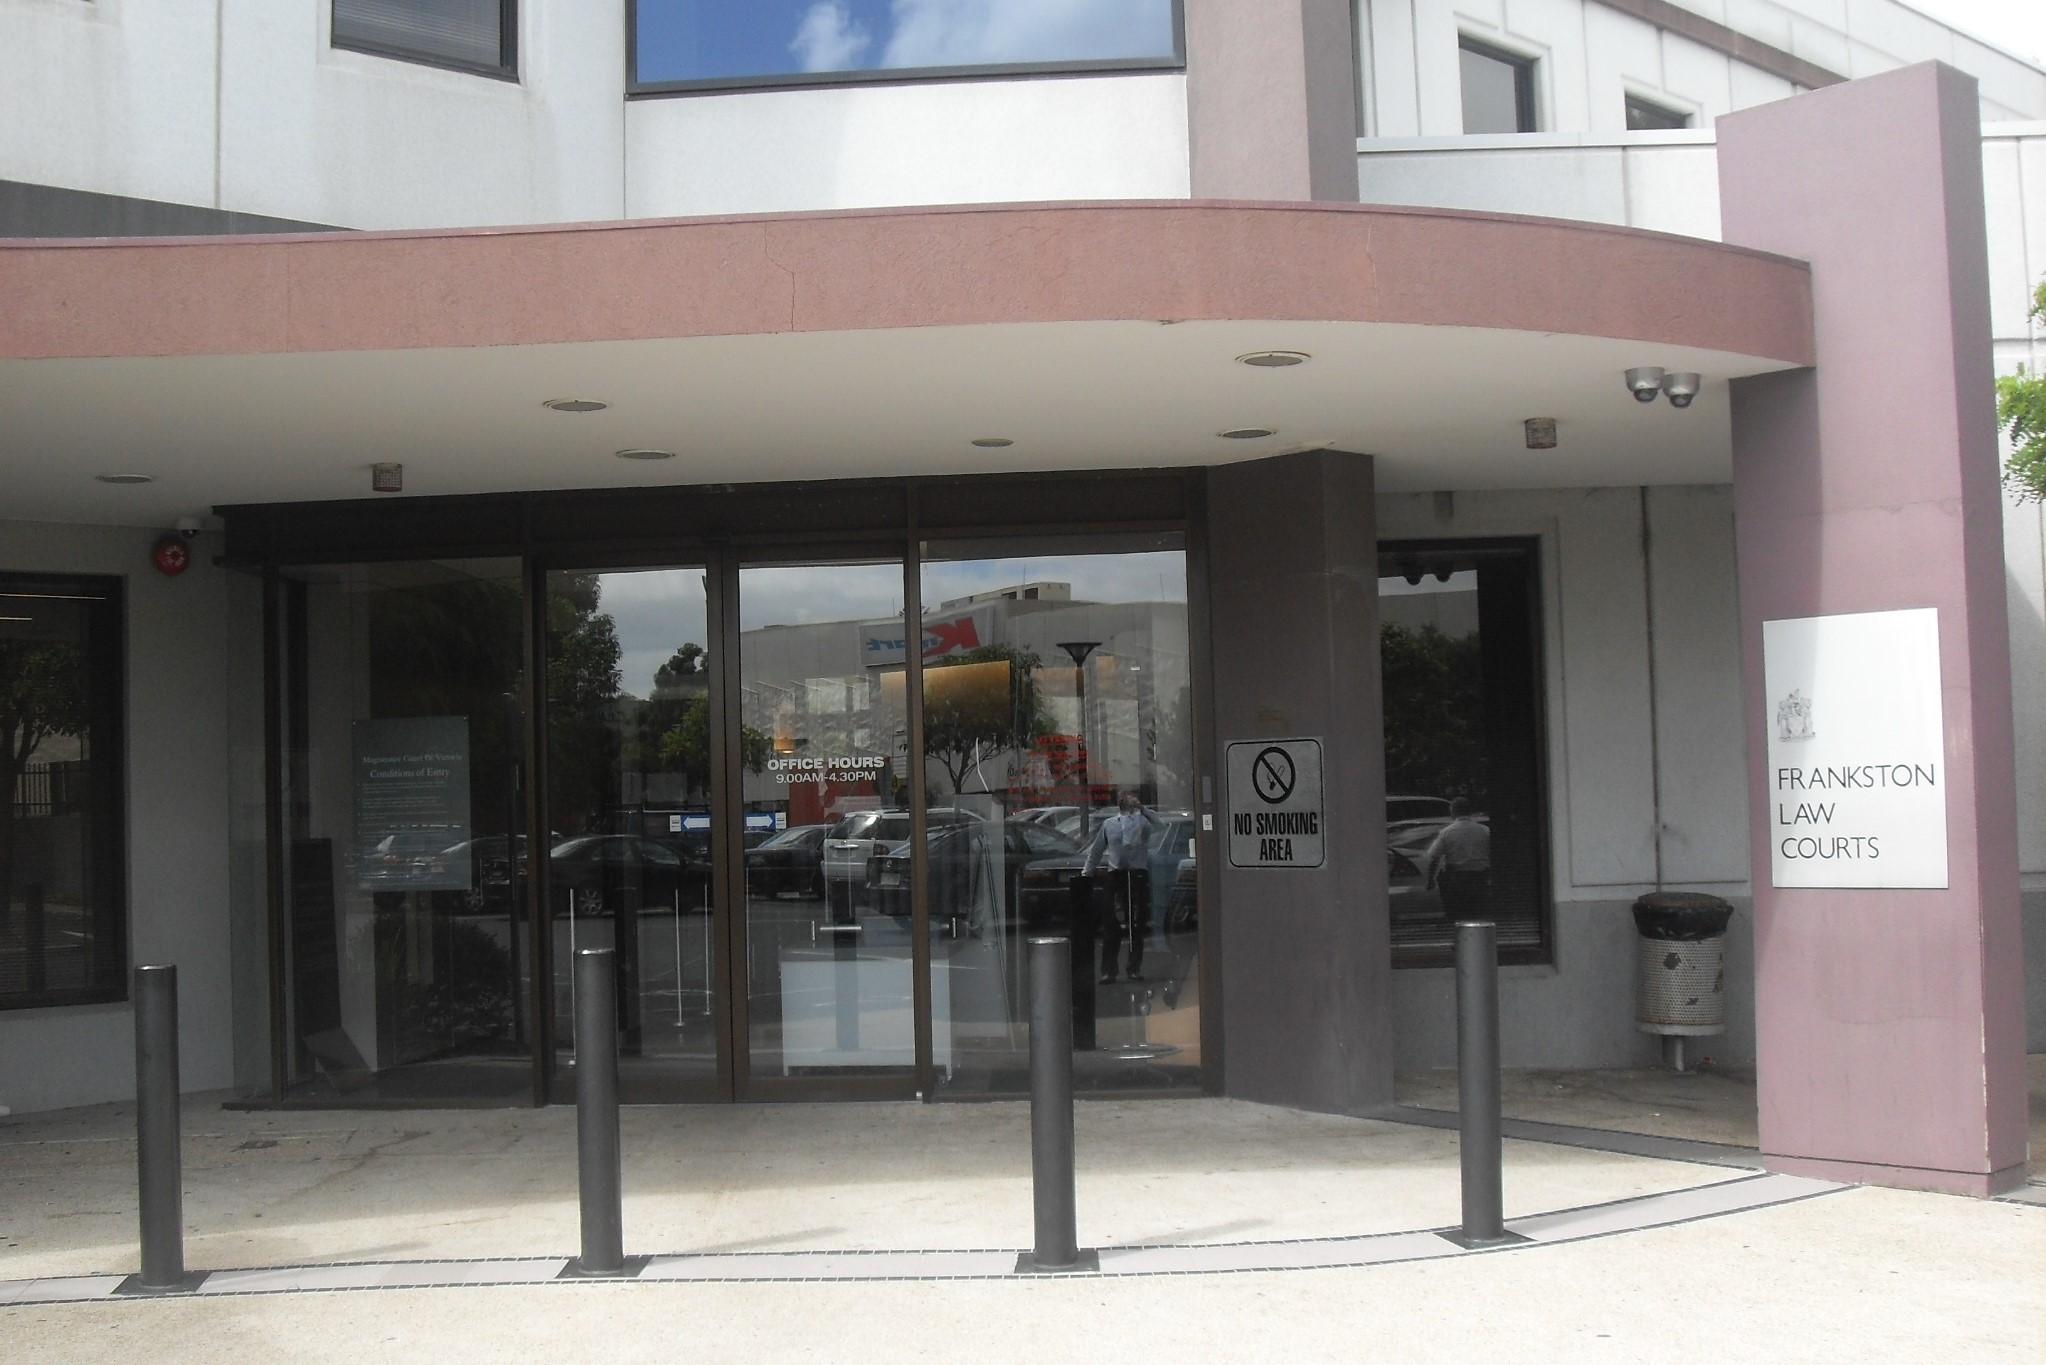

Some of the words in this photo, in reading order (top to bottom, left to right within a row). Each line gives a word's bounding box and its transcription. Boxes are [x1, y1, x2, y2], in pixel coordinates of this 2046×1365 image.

[370, 768, 415, 778] Conditions
[416, 768, 425, 777] of
[427, 768, 449, 778] Entry
[767, 758, 823, 770] OFFICE
[828, 756, 885, 769] HOURS
[776, 771, 876, 783] 9.00AM-4.30PM
[1778, 763, 1935, 790] FRANKSTON
[1234, 813, 1252, 835] NO
[1256, 812, 1318, 835] SMOKING
[1779, 802, 1836, 825] LAW
[1260, 839, 1293, 860] AREA
[1781, 836, 1880, 859] COURTS
